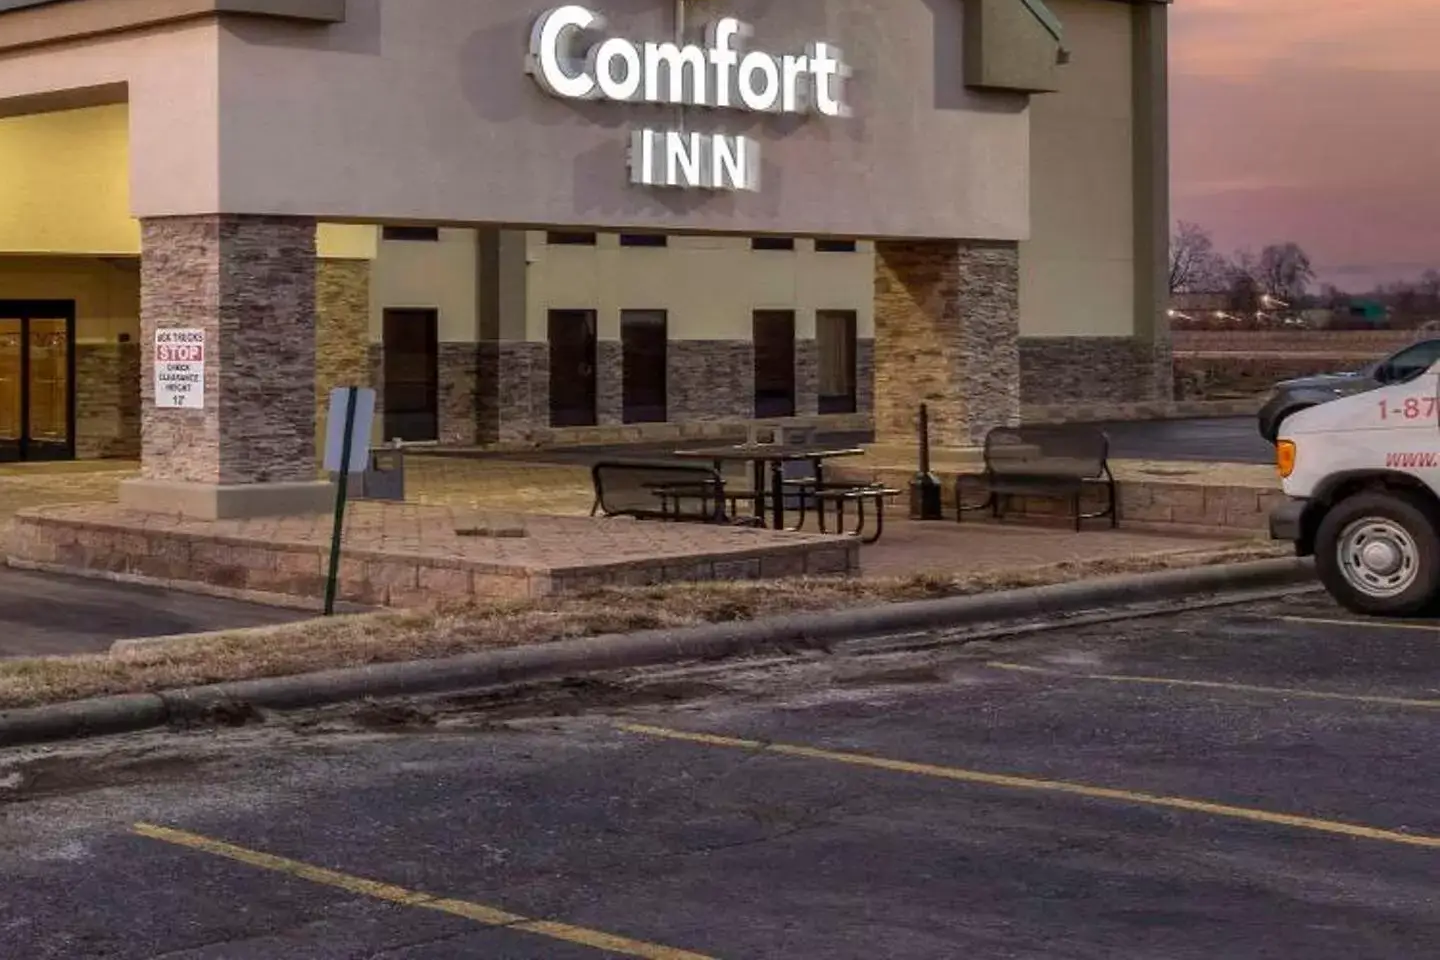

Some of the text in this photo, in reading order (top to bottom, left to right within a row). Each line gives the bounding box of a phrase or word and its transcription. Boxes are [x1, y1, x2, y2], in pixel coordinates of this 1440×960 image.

[539, 4, 840, 117] Comfort
[641, 128, 747, 190] INN
[159, 345, 200, 361] STOP
